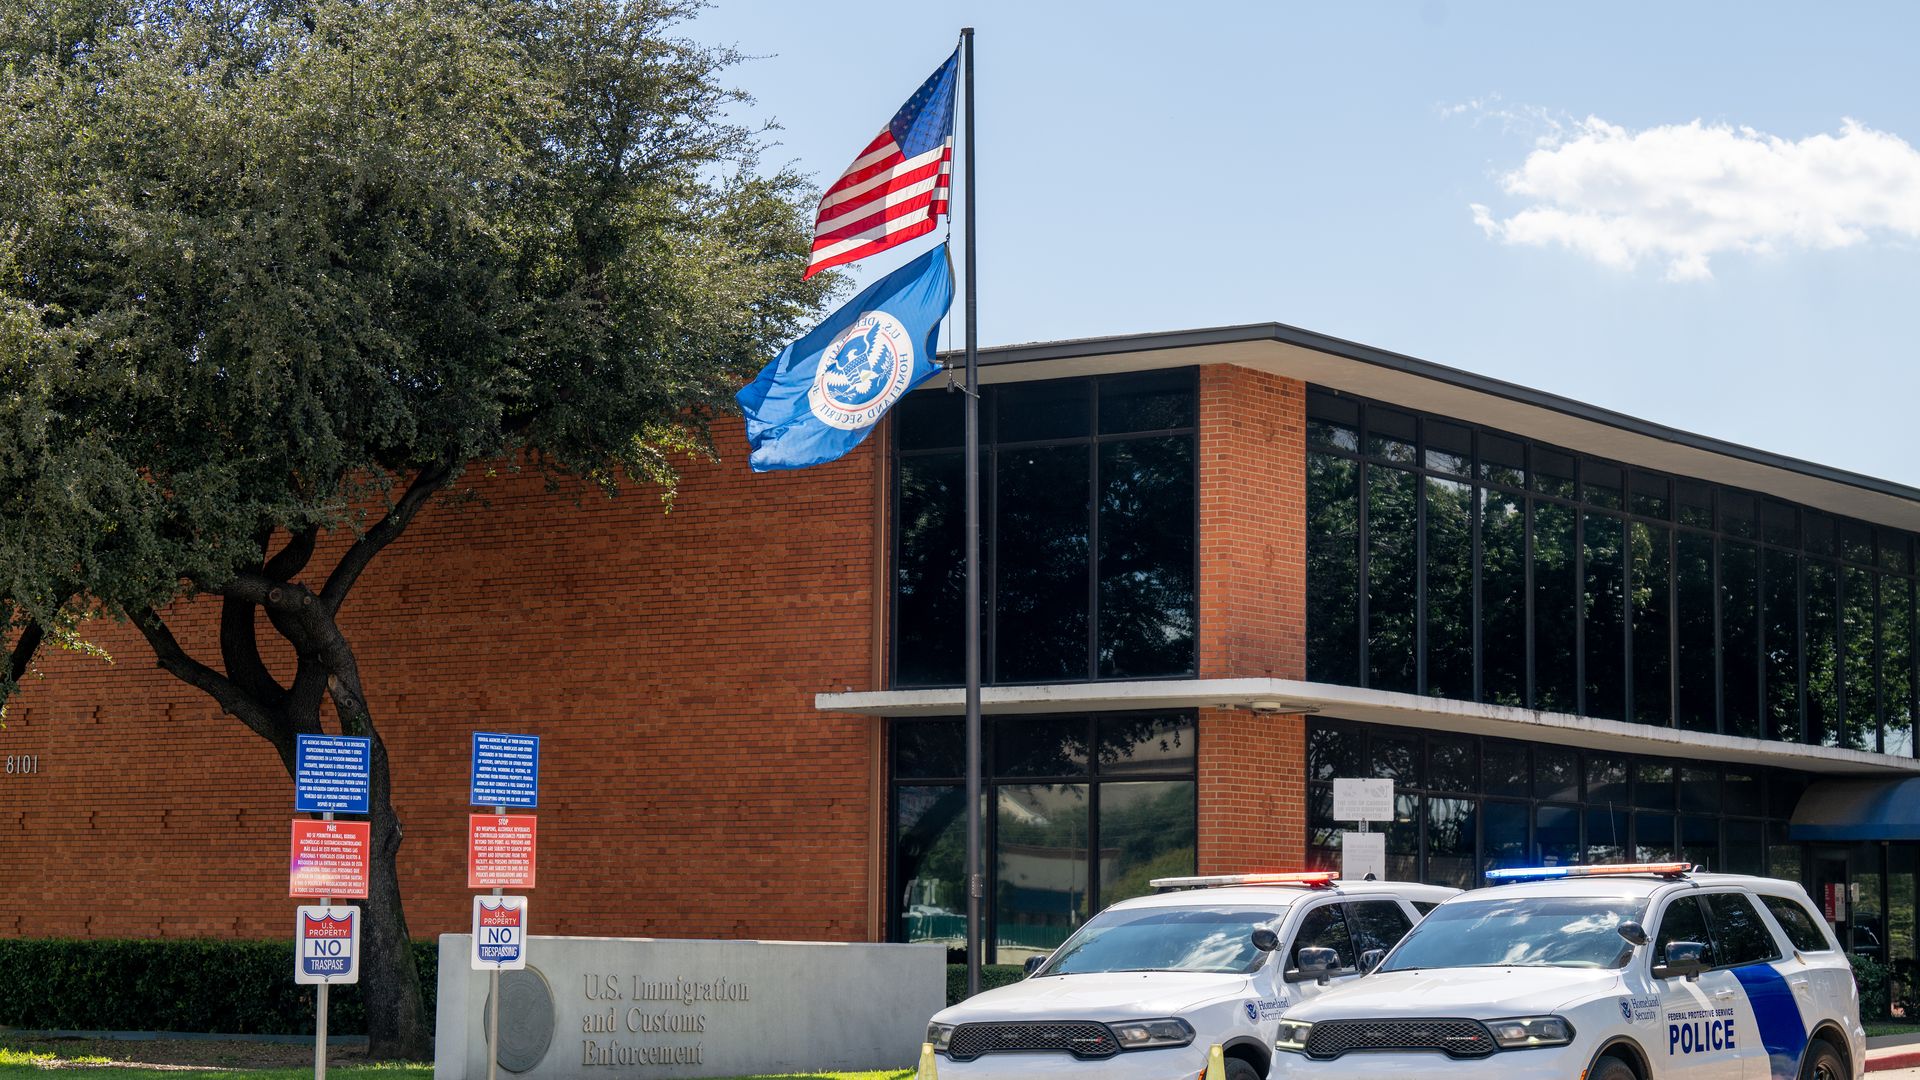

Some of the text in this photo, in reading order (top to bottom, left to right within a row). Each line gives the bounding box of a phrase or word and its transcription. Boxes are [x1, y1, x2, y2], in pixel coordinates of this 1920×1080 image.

[6, 755, 38, 774] 8101
[488, 928, 512, 943] NO
[314, 940, 341, 956] NO
[481, 947, 518, 957] TRESPASSING
[311, 960, 343, 970] TRASPASE
[583, 974, 750, 1006] U.S. Immigration
[1258, 997, 1289, 1010] Homeland
[1631, 995, 1659, 1009] Homeland
[582, 1006, 706, 1033] and Customs
[1635, 1009, 1656, 1022] Security
[1668, 1008, 1734, 1021] FEDERAL PROTECTIVE SERVICE
[1669, 1019, 1735, 1055] POLICE
[582, 1039, 705, 1066] Enforcement
